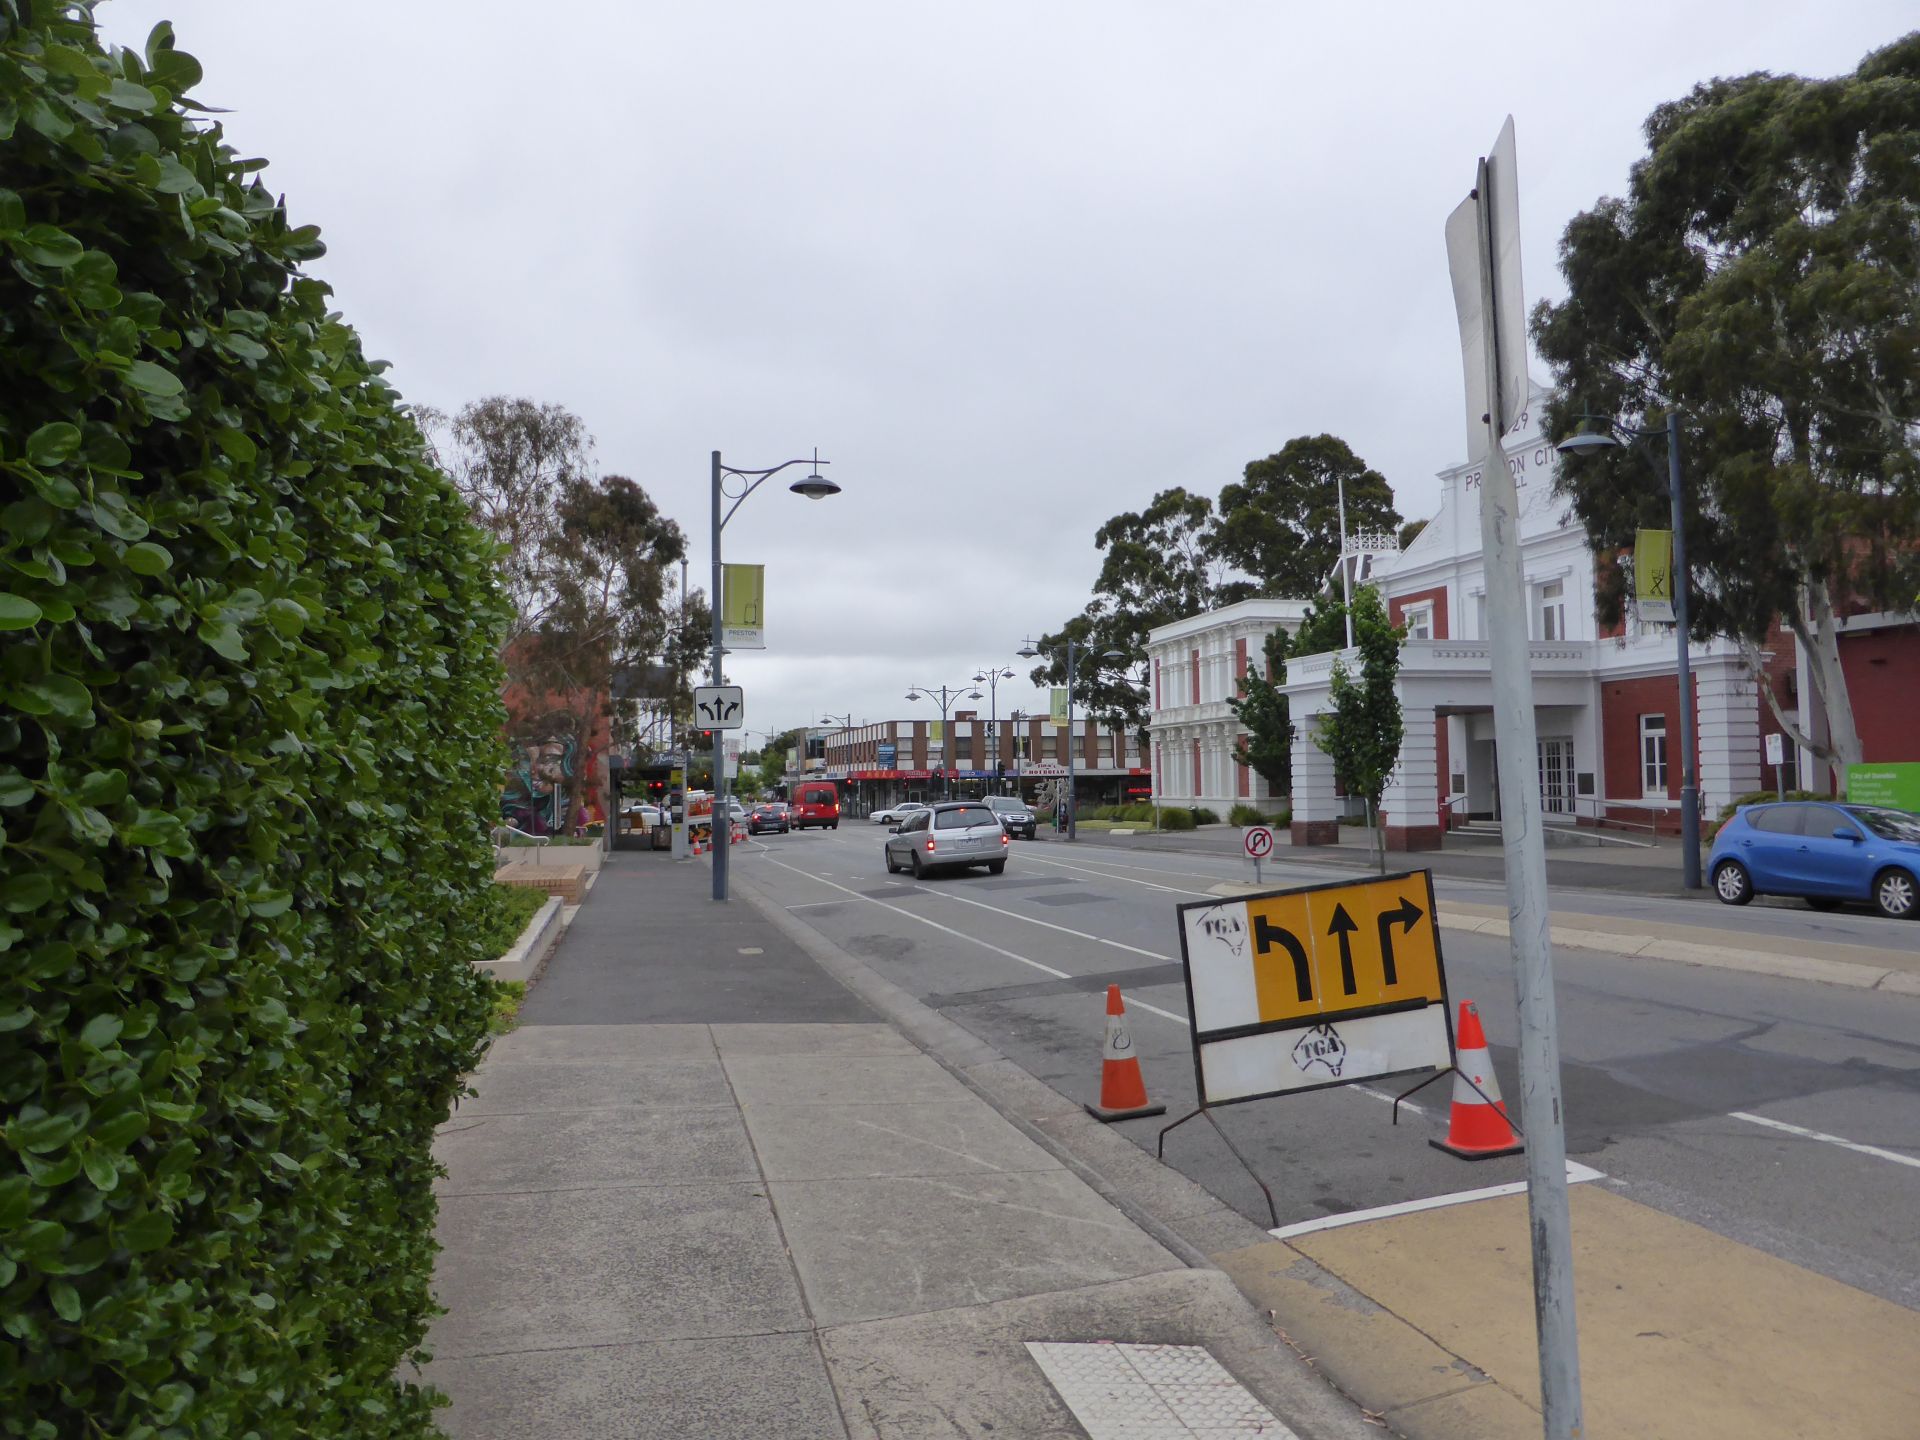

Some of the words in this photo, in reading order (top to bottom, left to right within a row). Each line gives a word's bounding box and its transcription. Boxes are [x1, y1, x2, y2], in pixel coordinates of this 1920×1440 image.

[1534, 446, 1556, 466] CIT
[728, 629, 757, 637] PRESTON
[1202, 917, 1241, 937] TGA
[1300, 1036, 1340, 1060] TGA
